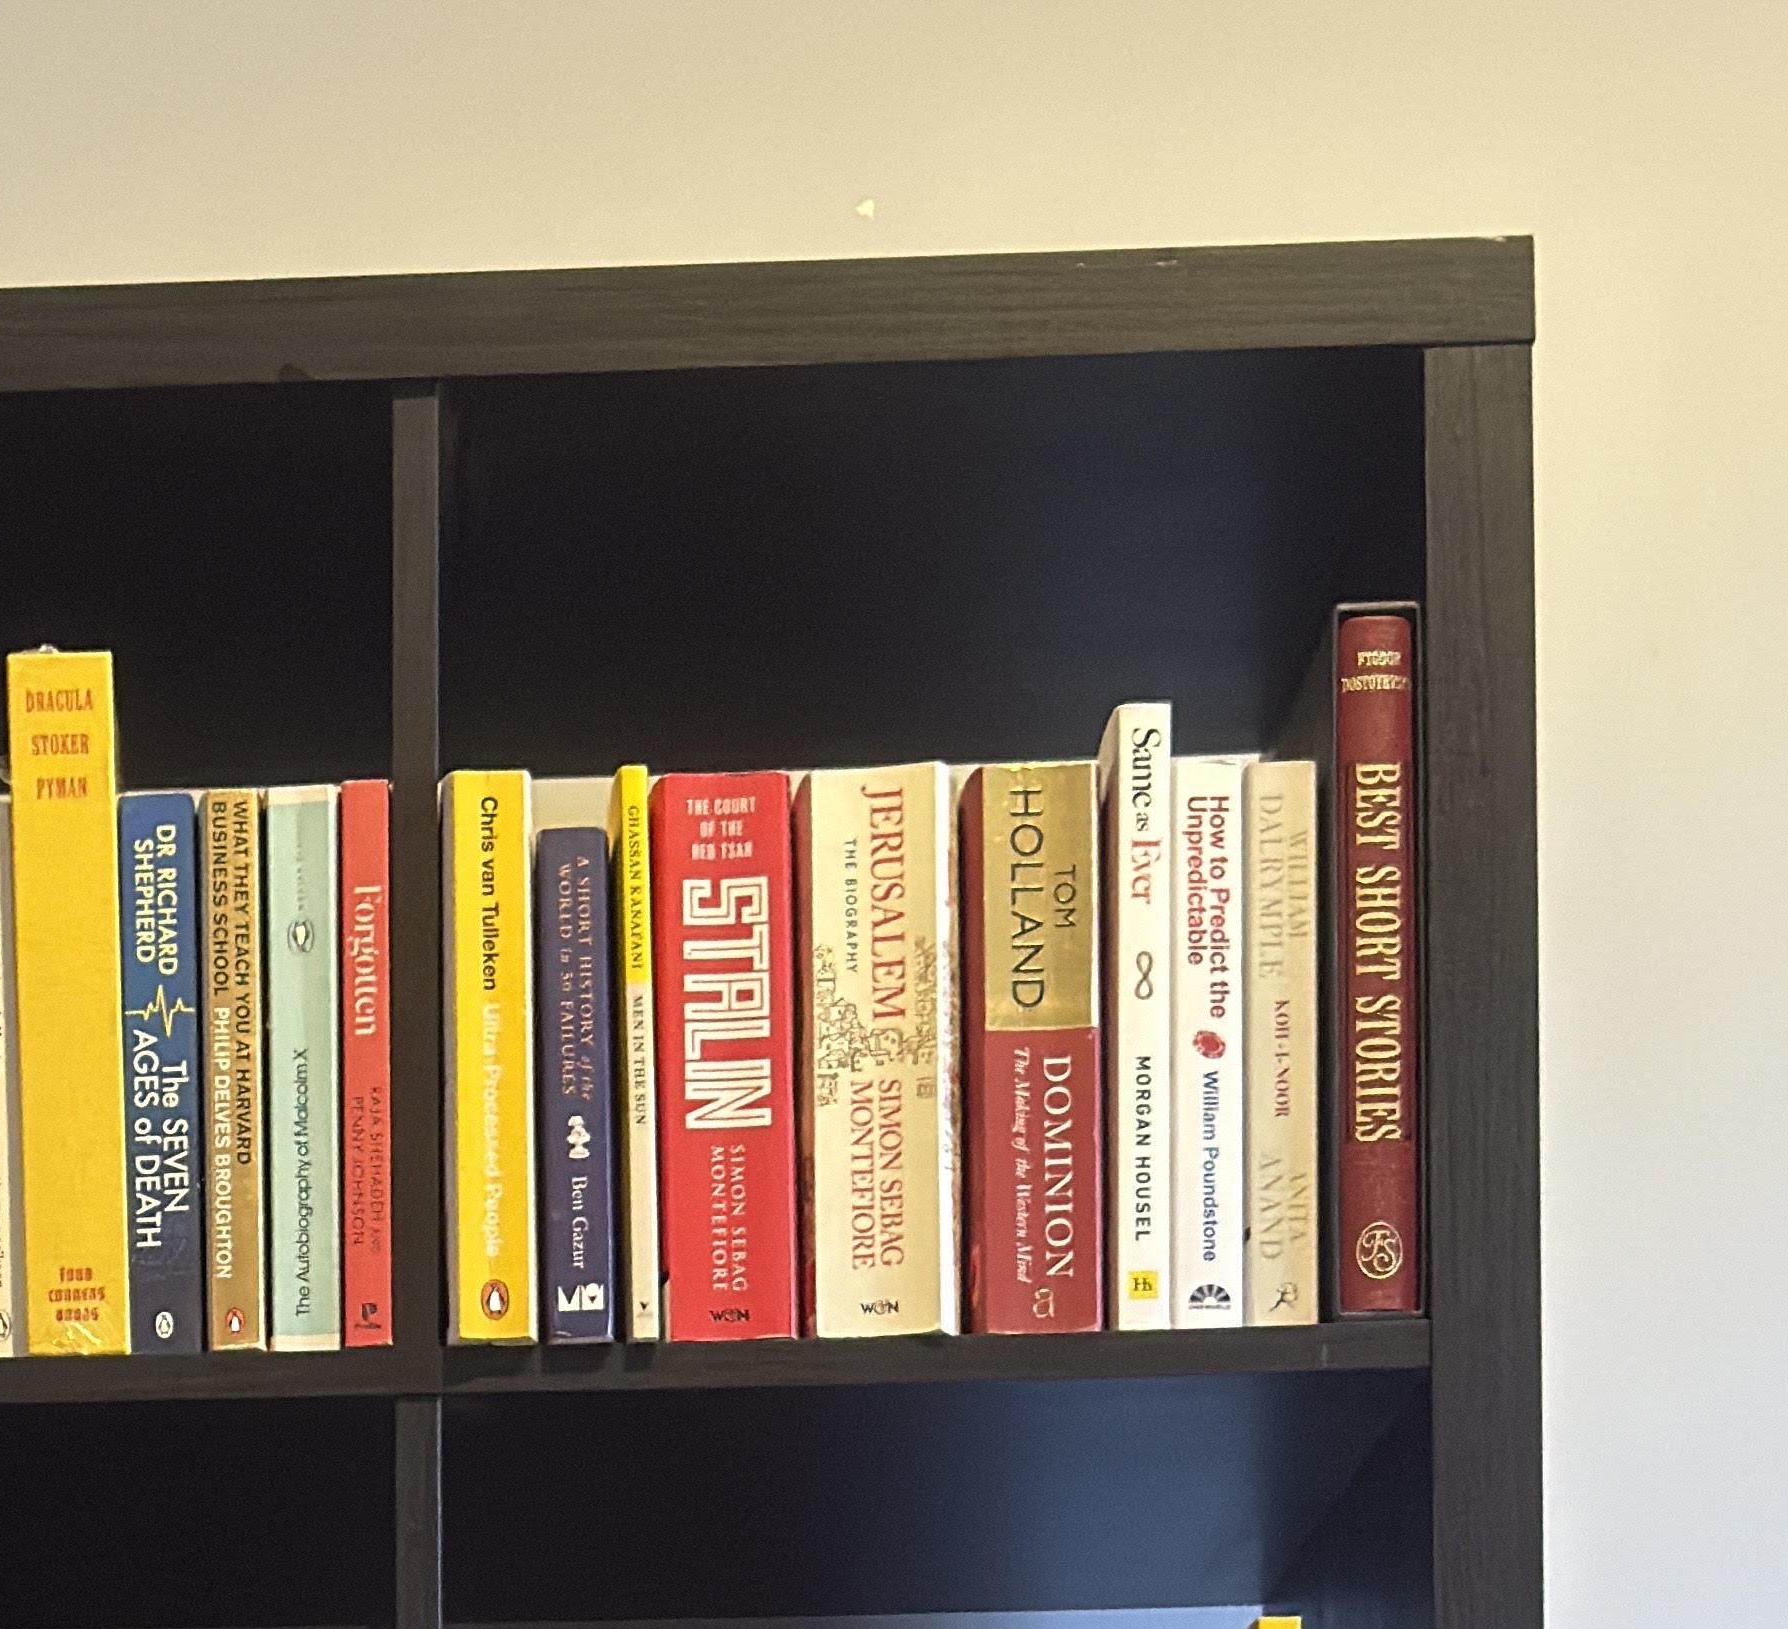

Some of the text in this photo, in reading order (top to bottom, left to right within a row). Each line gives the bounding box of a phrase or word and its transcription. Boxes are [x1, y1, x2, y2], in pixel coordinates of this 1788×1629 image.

[134, 839, 155, 963] SHEPHERD
[153, 825, 177, 976] DR RICHARD
[480, 796, 499, 991] Chris van Tulleken
[844, 839, 858, 972] THE BIOGRAPHY
[861, 786, 906, 1020] JERUSALEM
[1009, 786, 1046, 1011] HOLLAND
[1053, 865, 1077, 928] TOM
[1355, 763, 1402, 1142] BEST SHORT STORIES
[682, 876, 772, 1130] STALIN
[134, 1031, 162, 1248] AGES of DEATH
[163, 1062, 188, 1212] The SEVEN
[1042, 1055, 1074, 1278] DOMINION
[1135, 1056, 1152, 1241] MORGAN HOUSEL
[1202, 1070, 1220, 1262] William Poundstone
